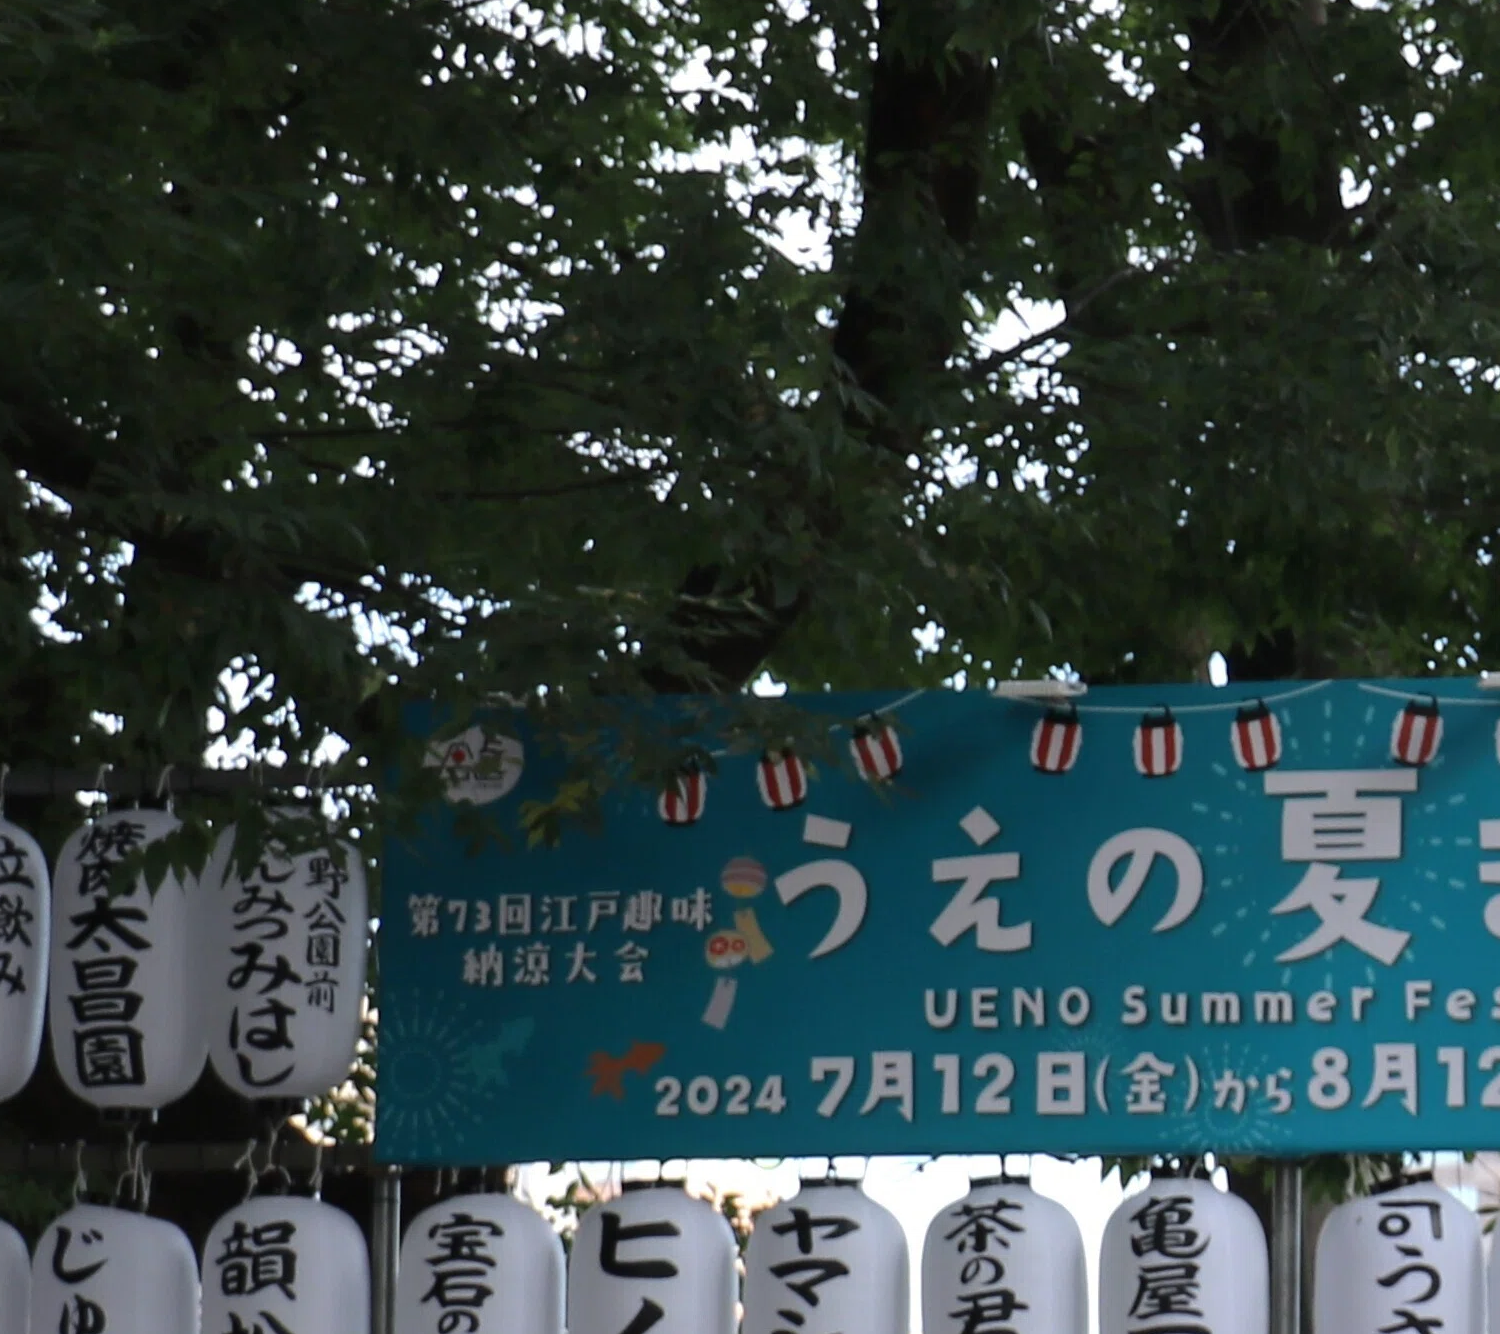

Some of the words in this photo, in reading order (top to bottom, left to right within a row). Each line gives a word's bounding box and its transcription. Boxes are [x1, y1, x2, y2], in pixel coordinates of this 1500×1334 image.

[304, 854, 350, 1014] 野公園前
[407, 887, 714, 938] 第73回江戸趣味
[461, 940, 652, 988] 納涼大会
[923, 984, 1092, 1028] UENO
[1120, 983, 1376, 1025] Summer
[655, 1074, 788, 1116] 2024
